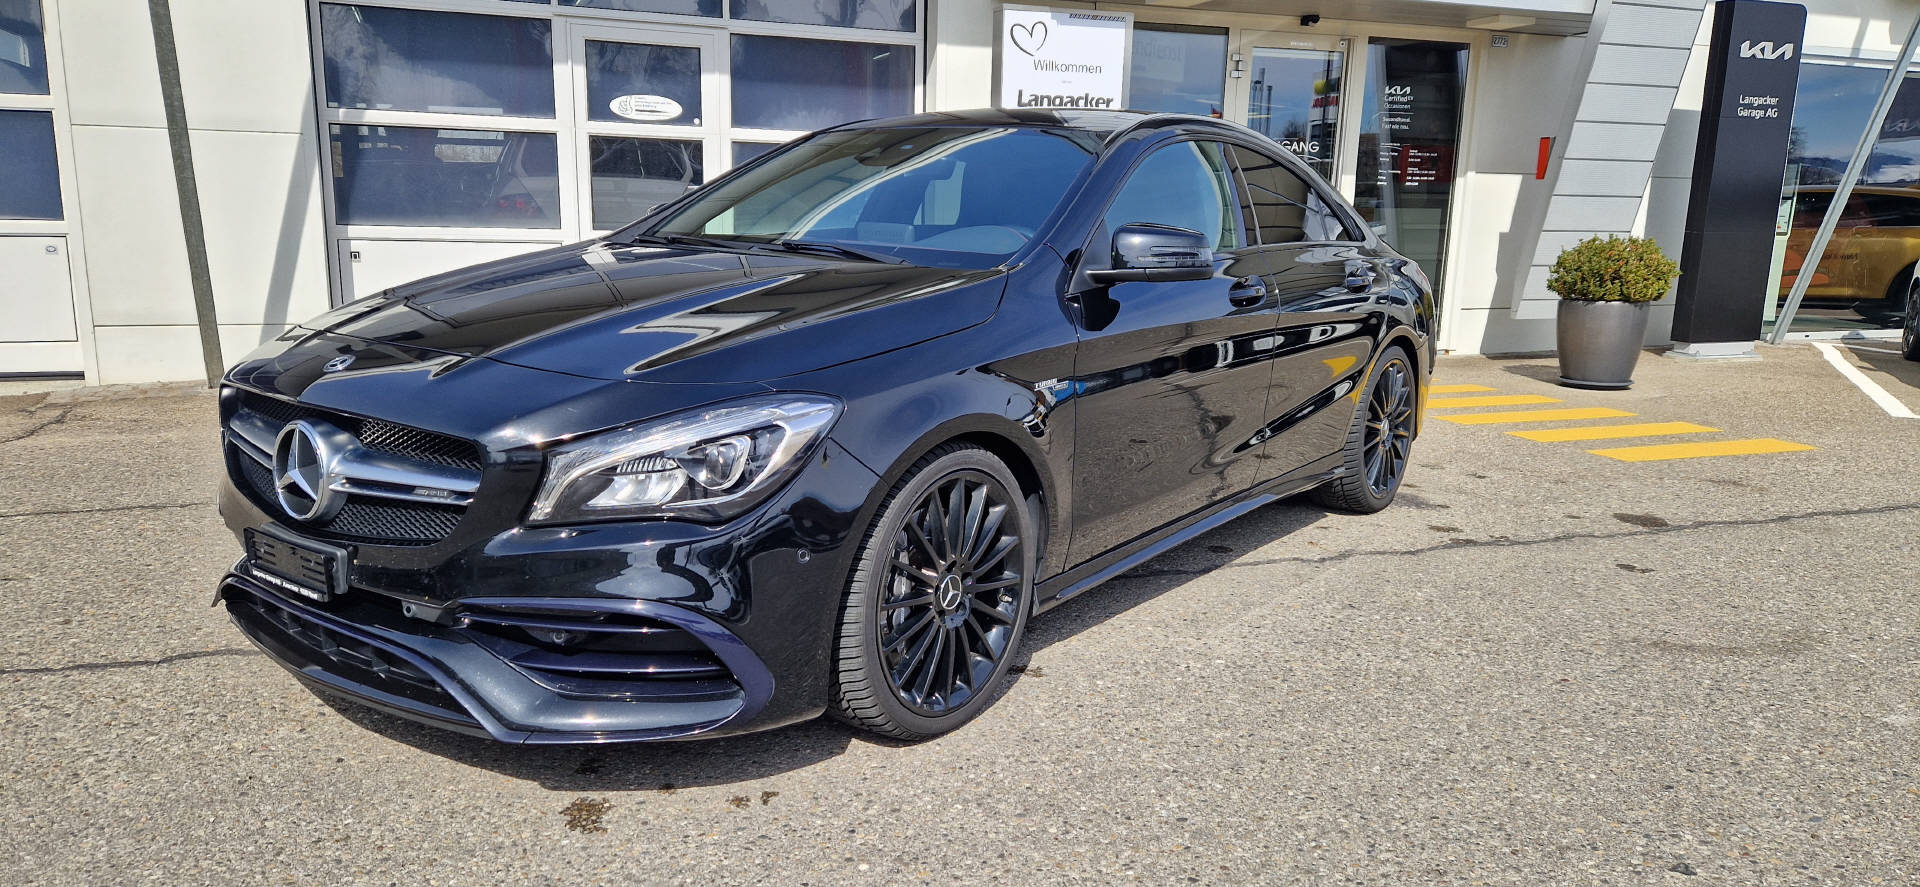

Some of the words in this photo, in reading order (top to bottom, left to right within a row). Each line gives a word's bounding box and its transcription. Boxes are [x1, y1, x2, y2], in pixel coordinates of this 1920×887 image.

[1033, 59, 1102, 74] Willkommen
[1739, 94, 1779, 106] Langacker
[1737, 107, 1765, 119] Garage
[1765, 107, 1778, 118] AG
[1281, 141, 1320, 153] GANG
